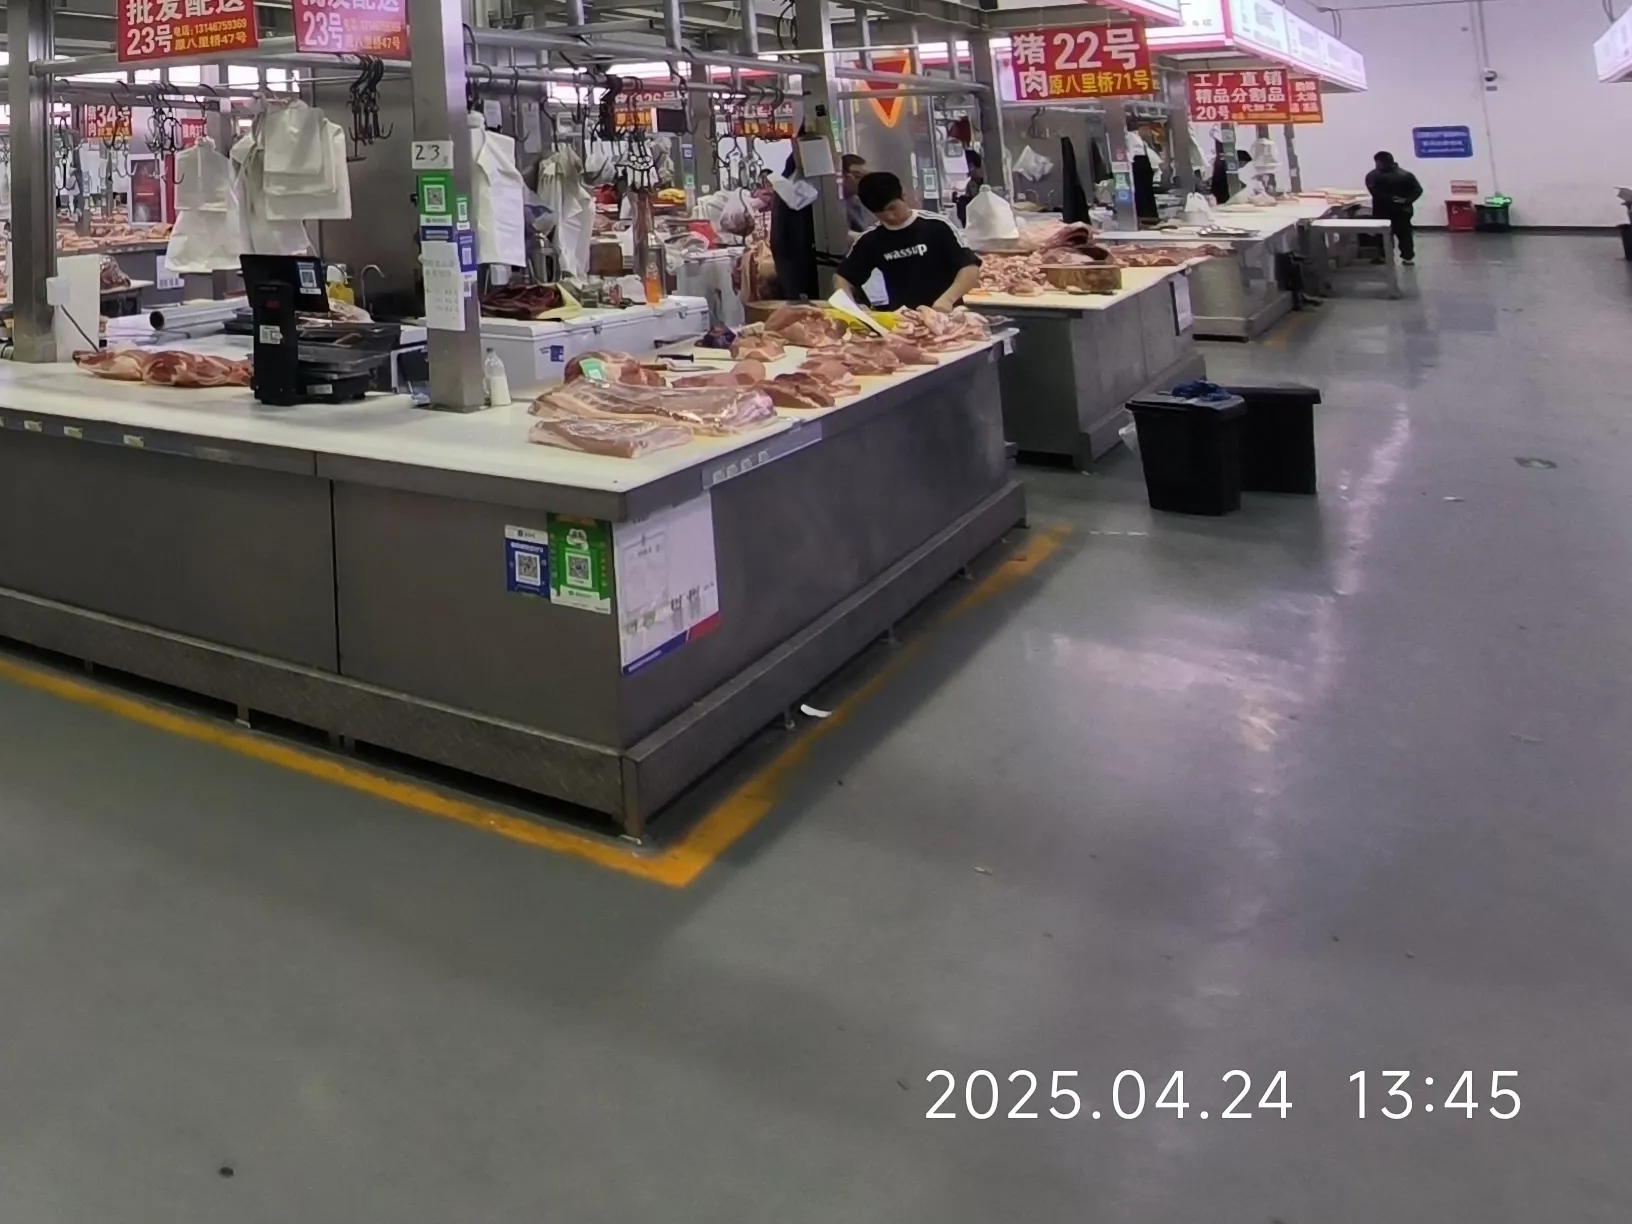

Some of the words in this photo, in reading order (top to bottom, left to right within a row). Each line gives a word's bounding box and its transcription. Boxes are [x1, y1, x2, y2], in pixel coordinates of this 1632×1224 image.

[127, 24, 172, 55] 23号
[303, 12, 343, 48] 23号
[1053, 28, 1140, 70] 22号
[1013, 33, 1049, 98] 猪肉
[1049, 70, 1150, 95] 原八里桥71号
[1196, 105, 1229, 120] 20号
[415, 145, 440, 161] 23
[883, 244, 927, 261] wassup
